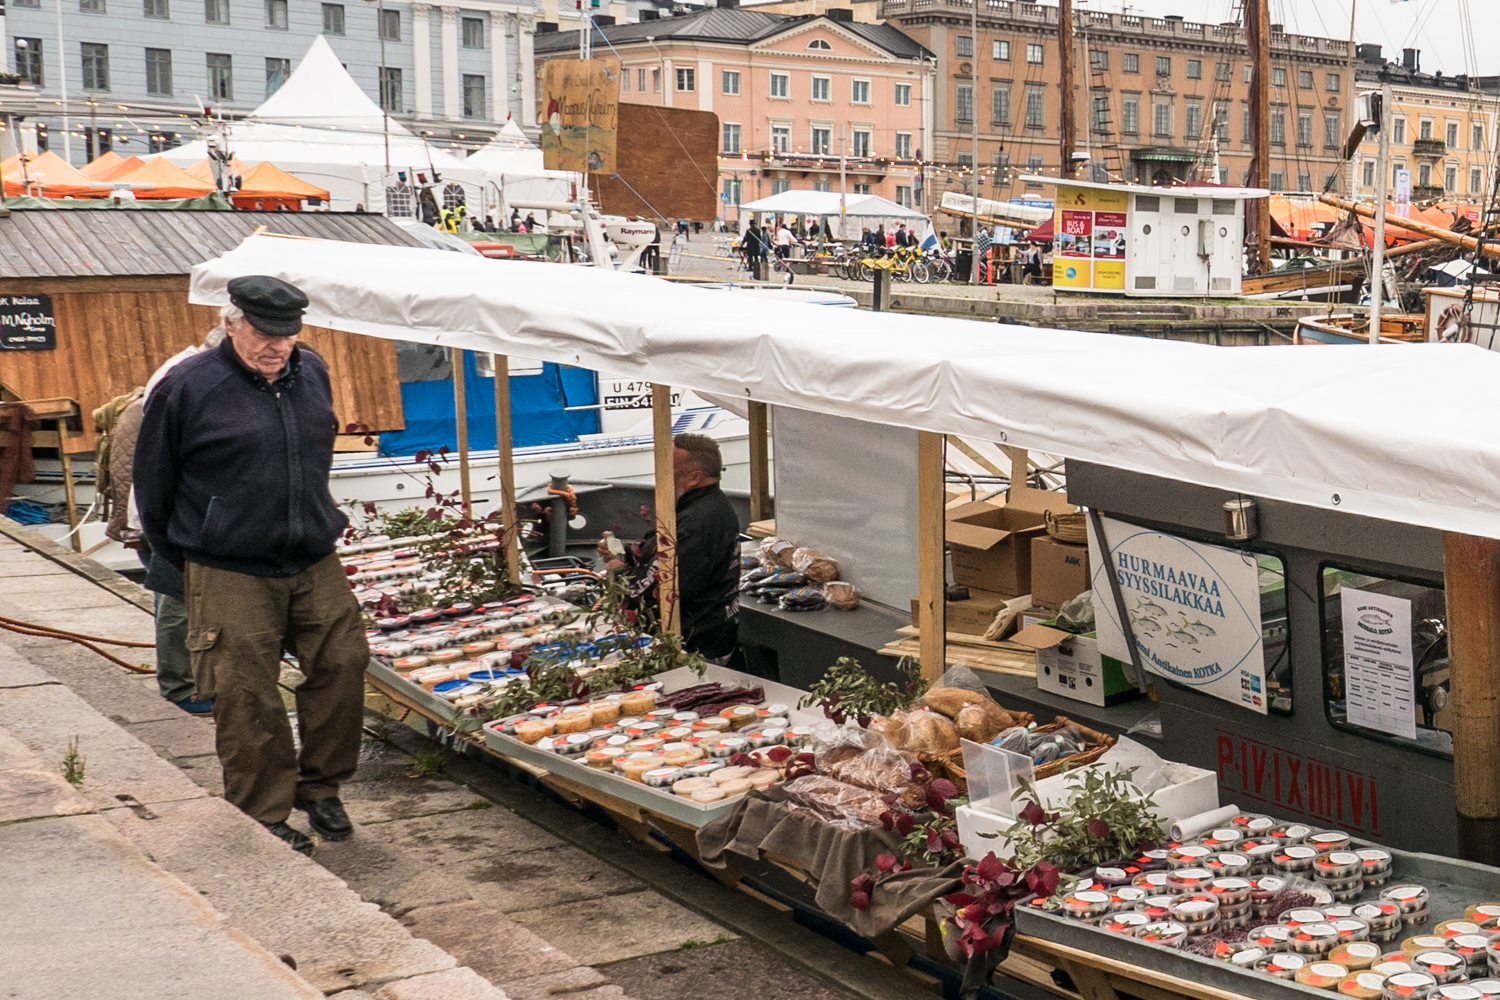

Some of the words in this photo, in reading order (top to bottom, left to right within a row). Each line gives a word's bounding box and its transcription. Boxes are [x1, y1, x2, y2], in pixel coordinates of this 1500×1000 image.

[1065, 555, 1081, 566] AAK
[1117, 551, 1222, 598] HURMAAVAA
[1117, 569, 1226, 618] SYYSSILAKKAA
[1151, 652, 1193, 679] Antikainen
[1194, 661, 1223, 679] KOTKA
